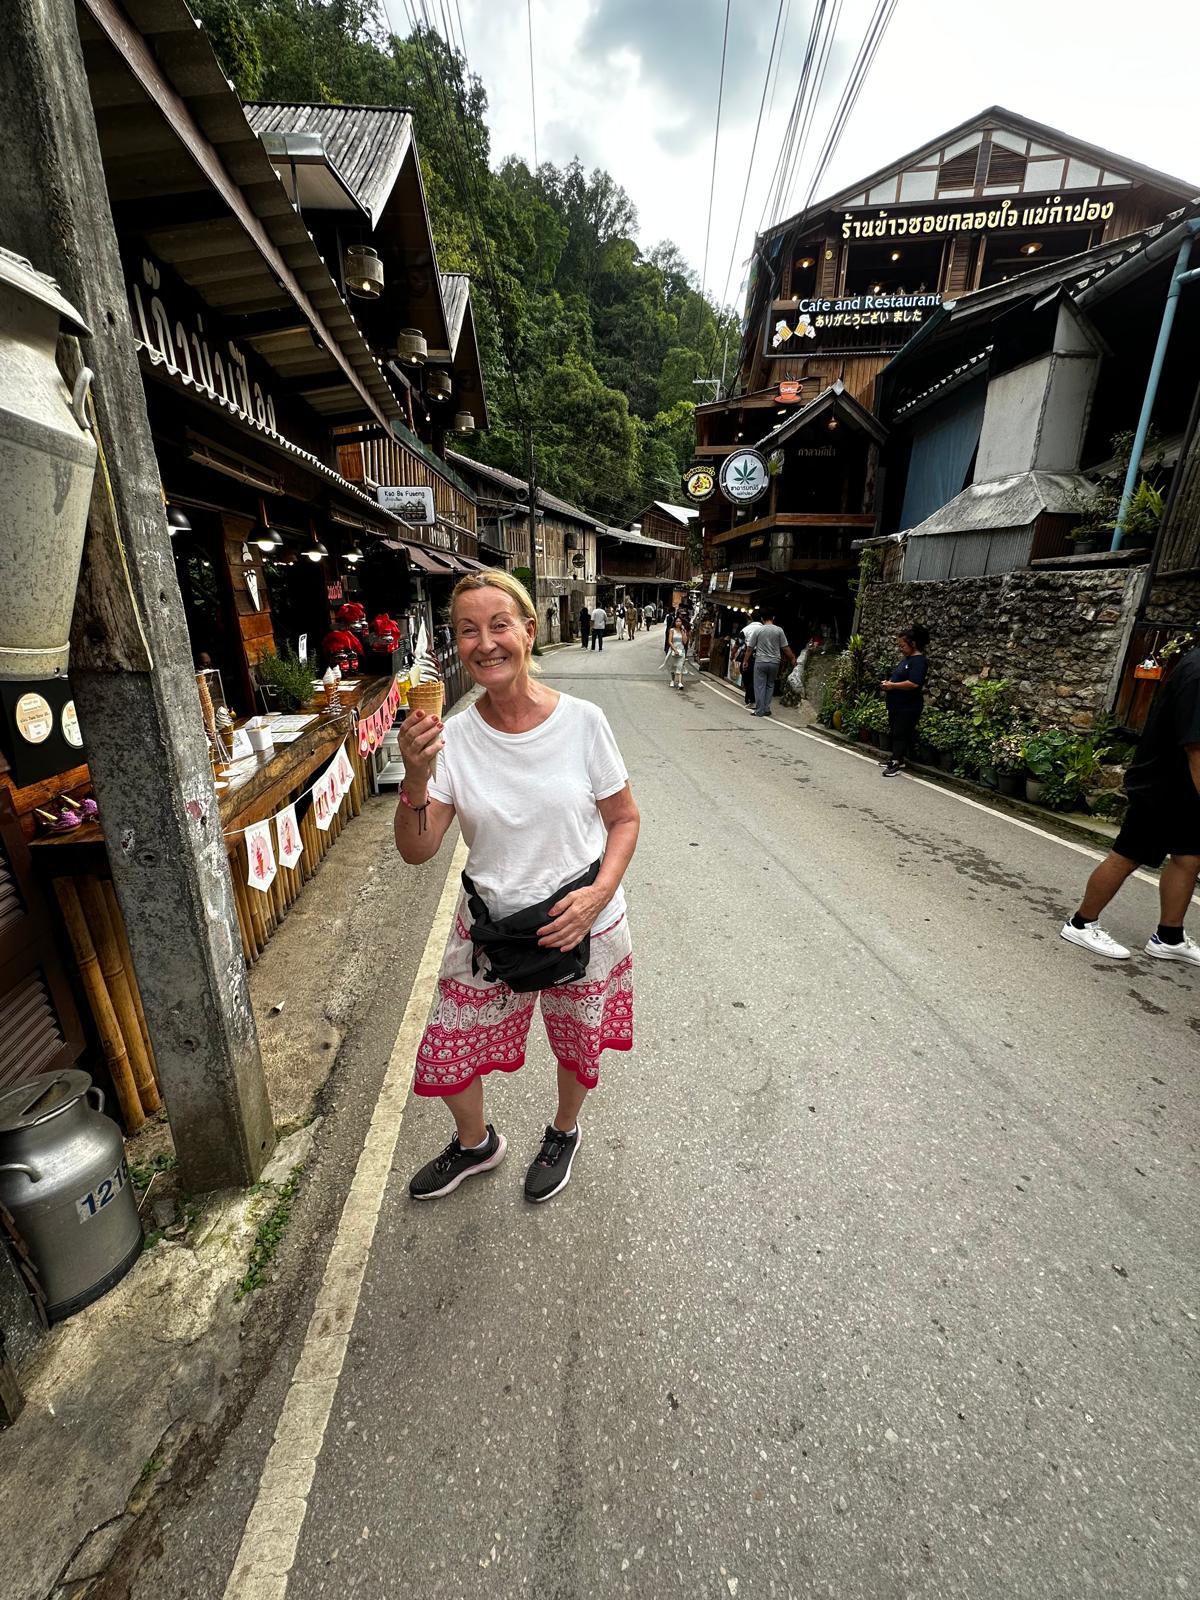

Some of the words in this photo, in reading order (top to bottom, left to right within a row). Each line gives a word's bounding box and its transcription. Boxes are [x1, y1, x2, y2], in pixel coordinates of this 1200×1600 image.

[842, 200, 1018, 239] ร้านข้าวซอยกลอยใจ
[1022, 196, 1114, 226] แม่กำปอง
[800, 298, 831, 312] Cafe
[834, 296, 861, 311] and
[865, 293, 941, 309] Restaurant
